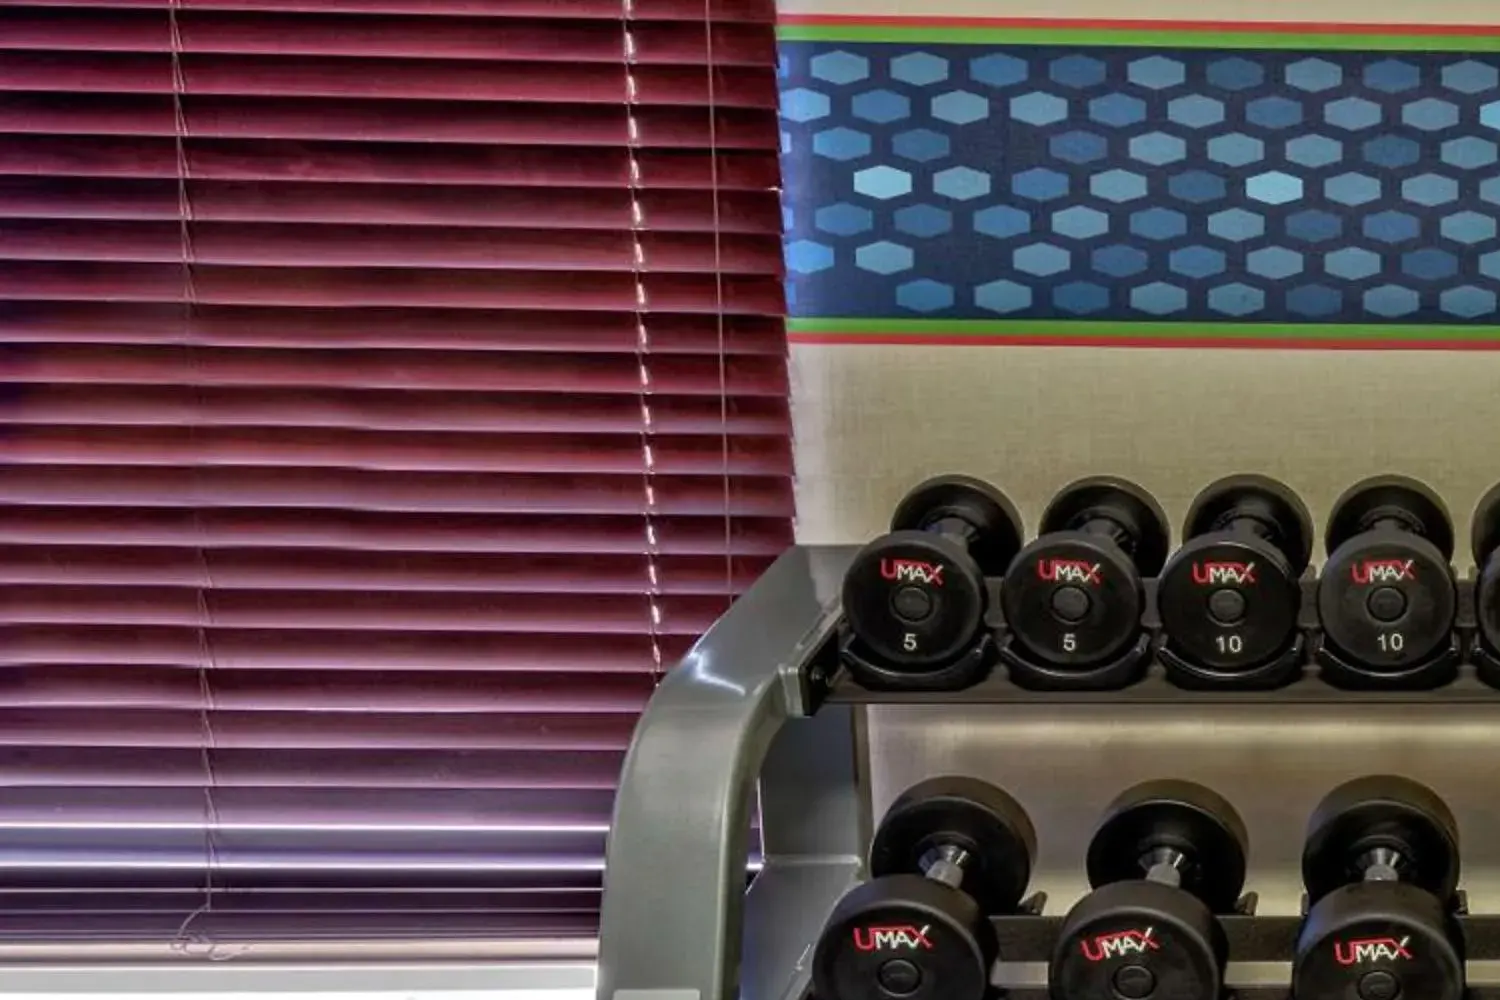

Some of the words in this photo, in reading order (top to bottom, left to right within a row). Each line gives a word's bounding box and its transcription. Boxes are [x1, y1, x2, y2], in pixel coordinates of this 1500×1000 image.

[881, 559, 943, 584] UMAX
[1038, 559, 1101, 583] UMAX
[1192, 562, 1254, 584] UMAX
[1351, 559, 1413, 584] UMAX
[903, 633, 917, 650] 5
[1063, 633, 1076, 652] 5
[1216, 635, 1242, 653] 10
[1377, 633, 1403, 651] 10
[853, 925, 932, 951] UMAX
[1081, 927, 1158, 961] UMAX
[1334, 936, 1411, 965] UMAX
